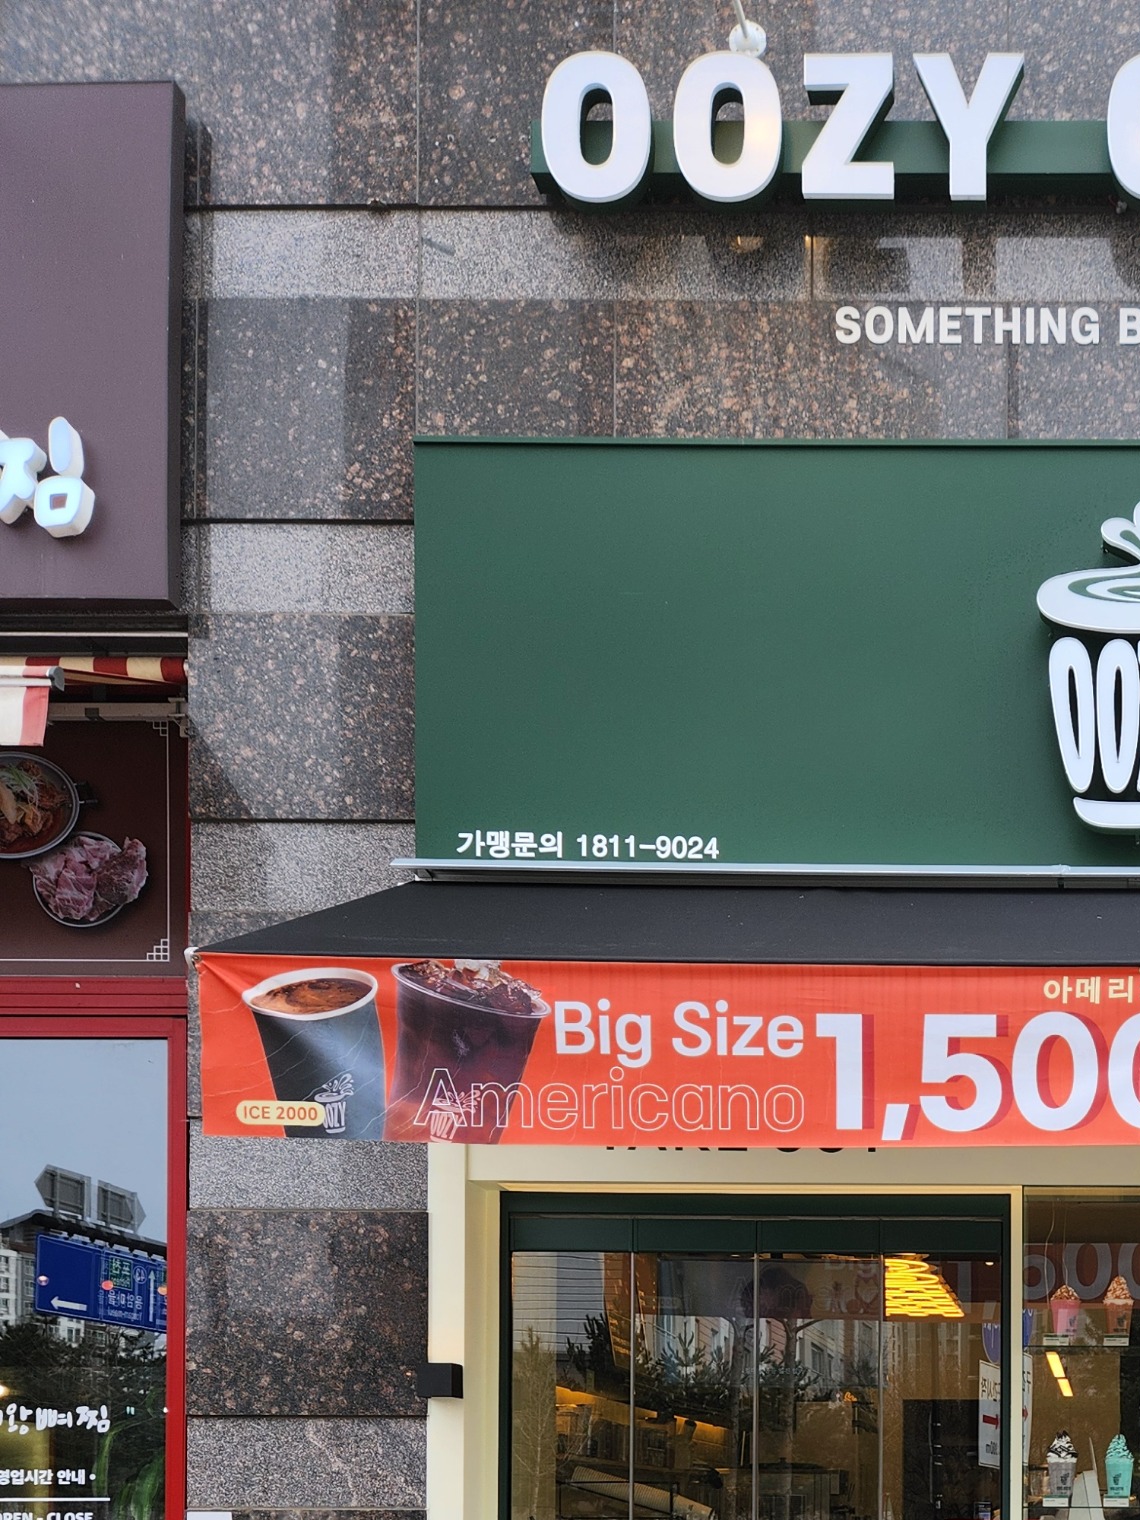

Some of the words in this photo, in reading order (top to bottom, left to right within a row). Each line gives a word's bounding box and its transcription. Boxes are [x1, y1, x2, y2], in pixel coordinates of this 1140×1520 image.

[540, 50, 1025, 203] OOZY
[834, 305, 1100, 345] SOMETHING
[456, 829, 564, 859] 가맹문의
[576, 833, 720, 860] 1811-9024
[555, 999, 652, 1068] Big
[672, 999, 804, 1058] Size
[243, 1105, 272, 1121] ICE
[275, 1105, 318, 1121] 2000
[413, 1065, 805, 1131] Americano
[57, 1469, 86, 1485] 안내
